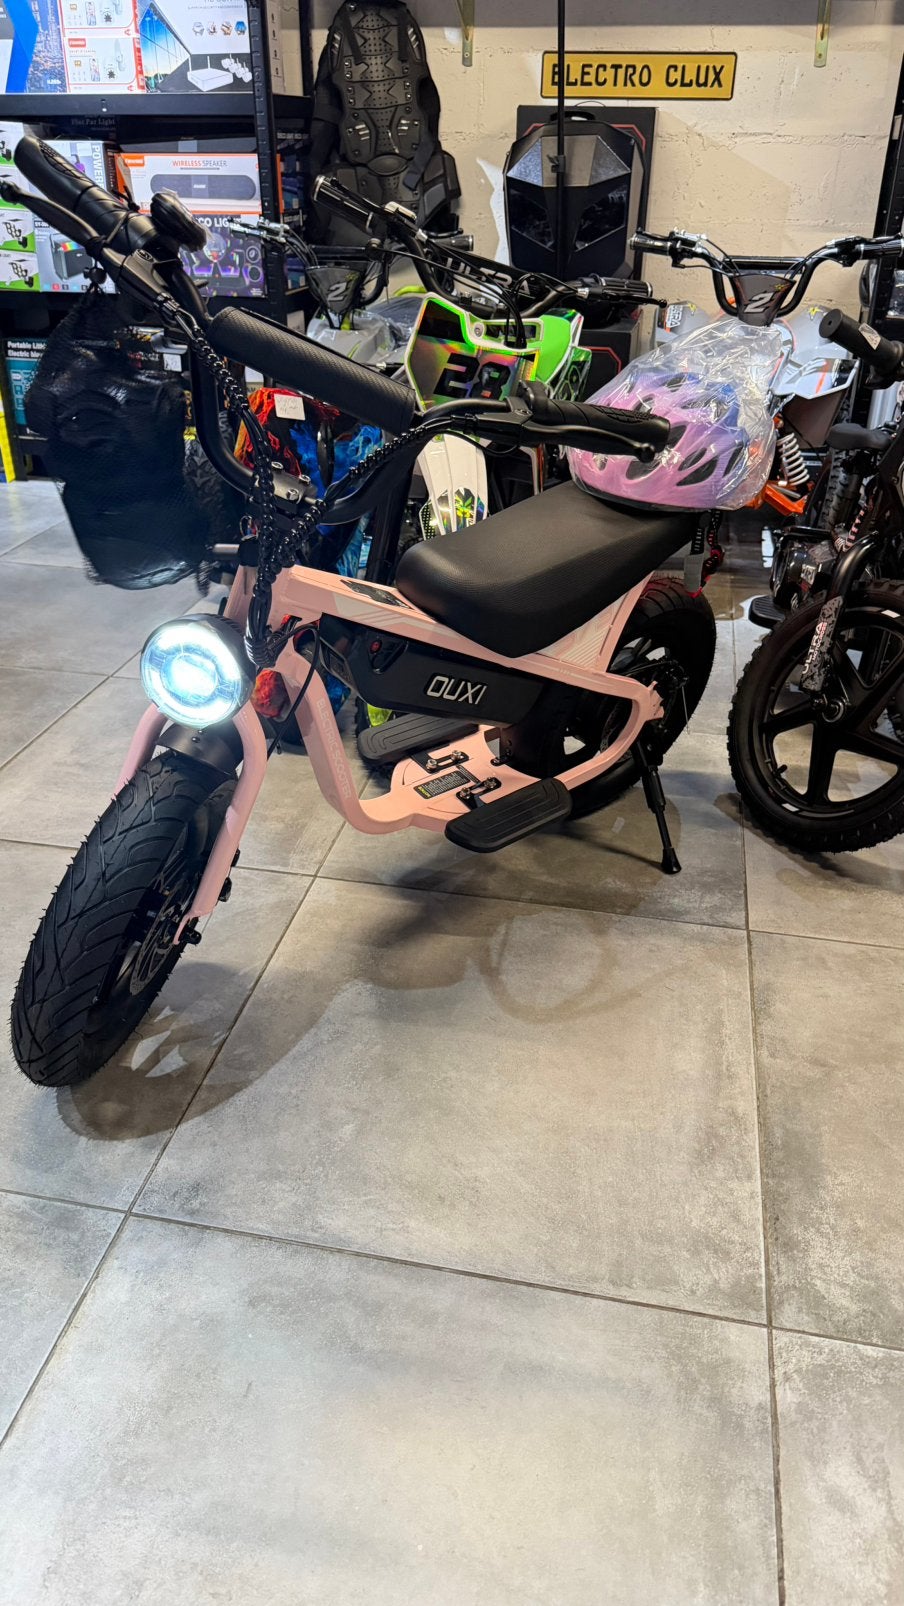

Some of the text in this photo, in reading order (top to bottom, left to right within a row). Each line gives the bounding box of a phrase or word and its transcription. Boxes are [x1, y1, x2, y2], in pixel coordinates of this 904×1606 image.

[551, 63, 726, 88] ELECTRO CLUX
[172, 159, 228, 167] WIRELESS SPEAKER
[327, 282, 347, 301] 2
[743, 291, 774, 313] 2
[7, 341, 32, 349] Portable
[7, 349, 30, 357] Electric
[802, 622, 824, 674] ULTRA
[427, 675, 487, 704] OUXI
[317, 698, 352, 799] ELECTRIC SCOOTER
